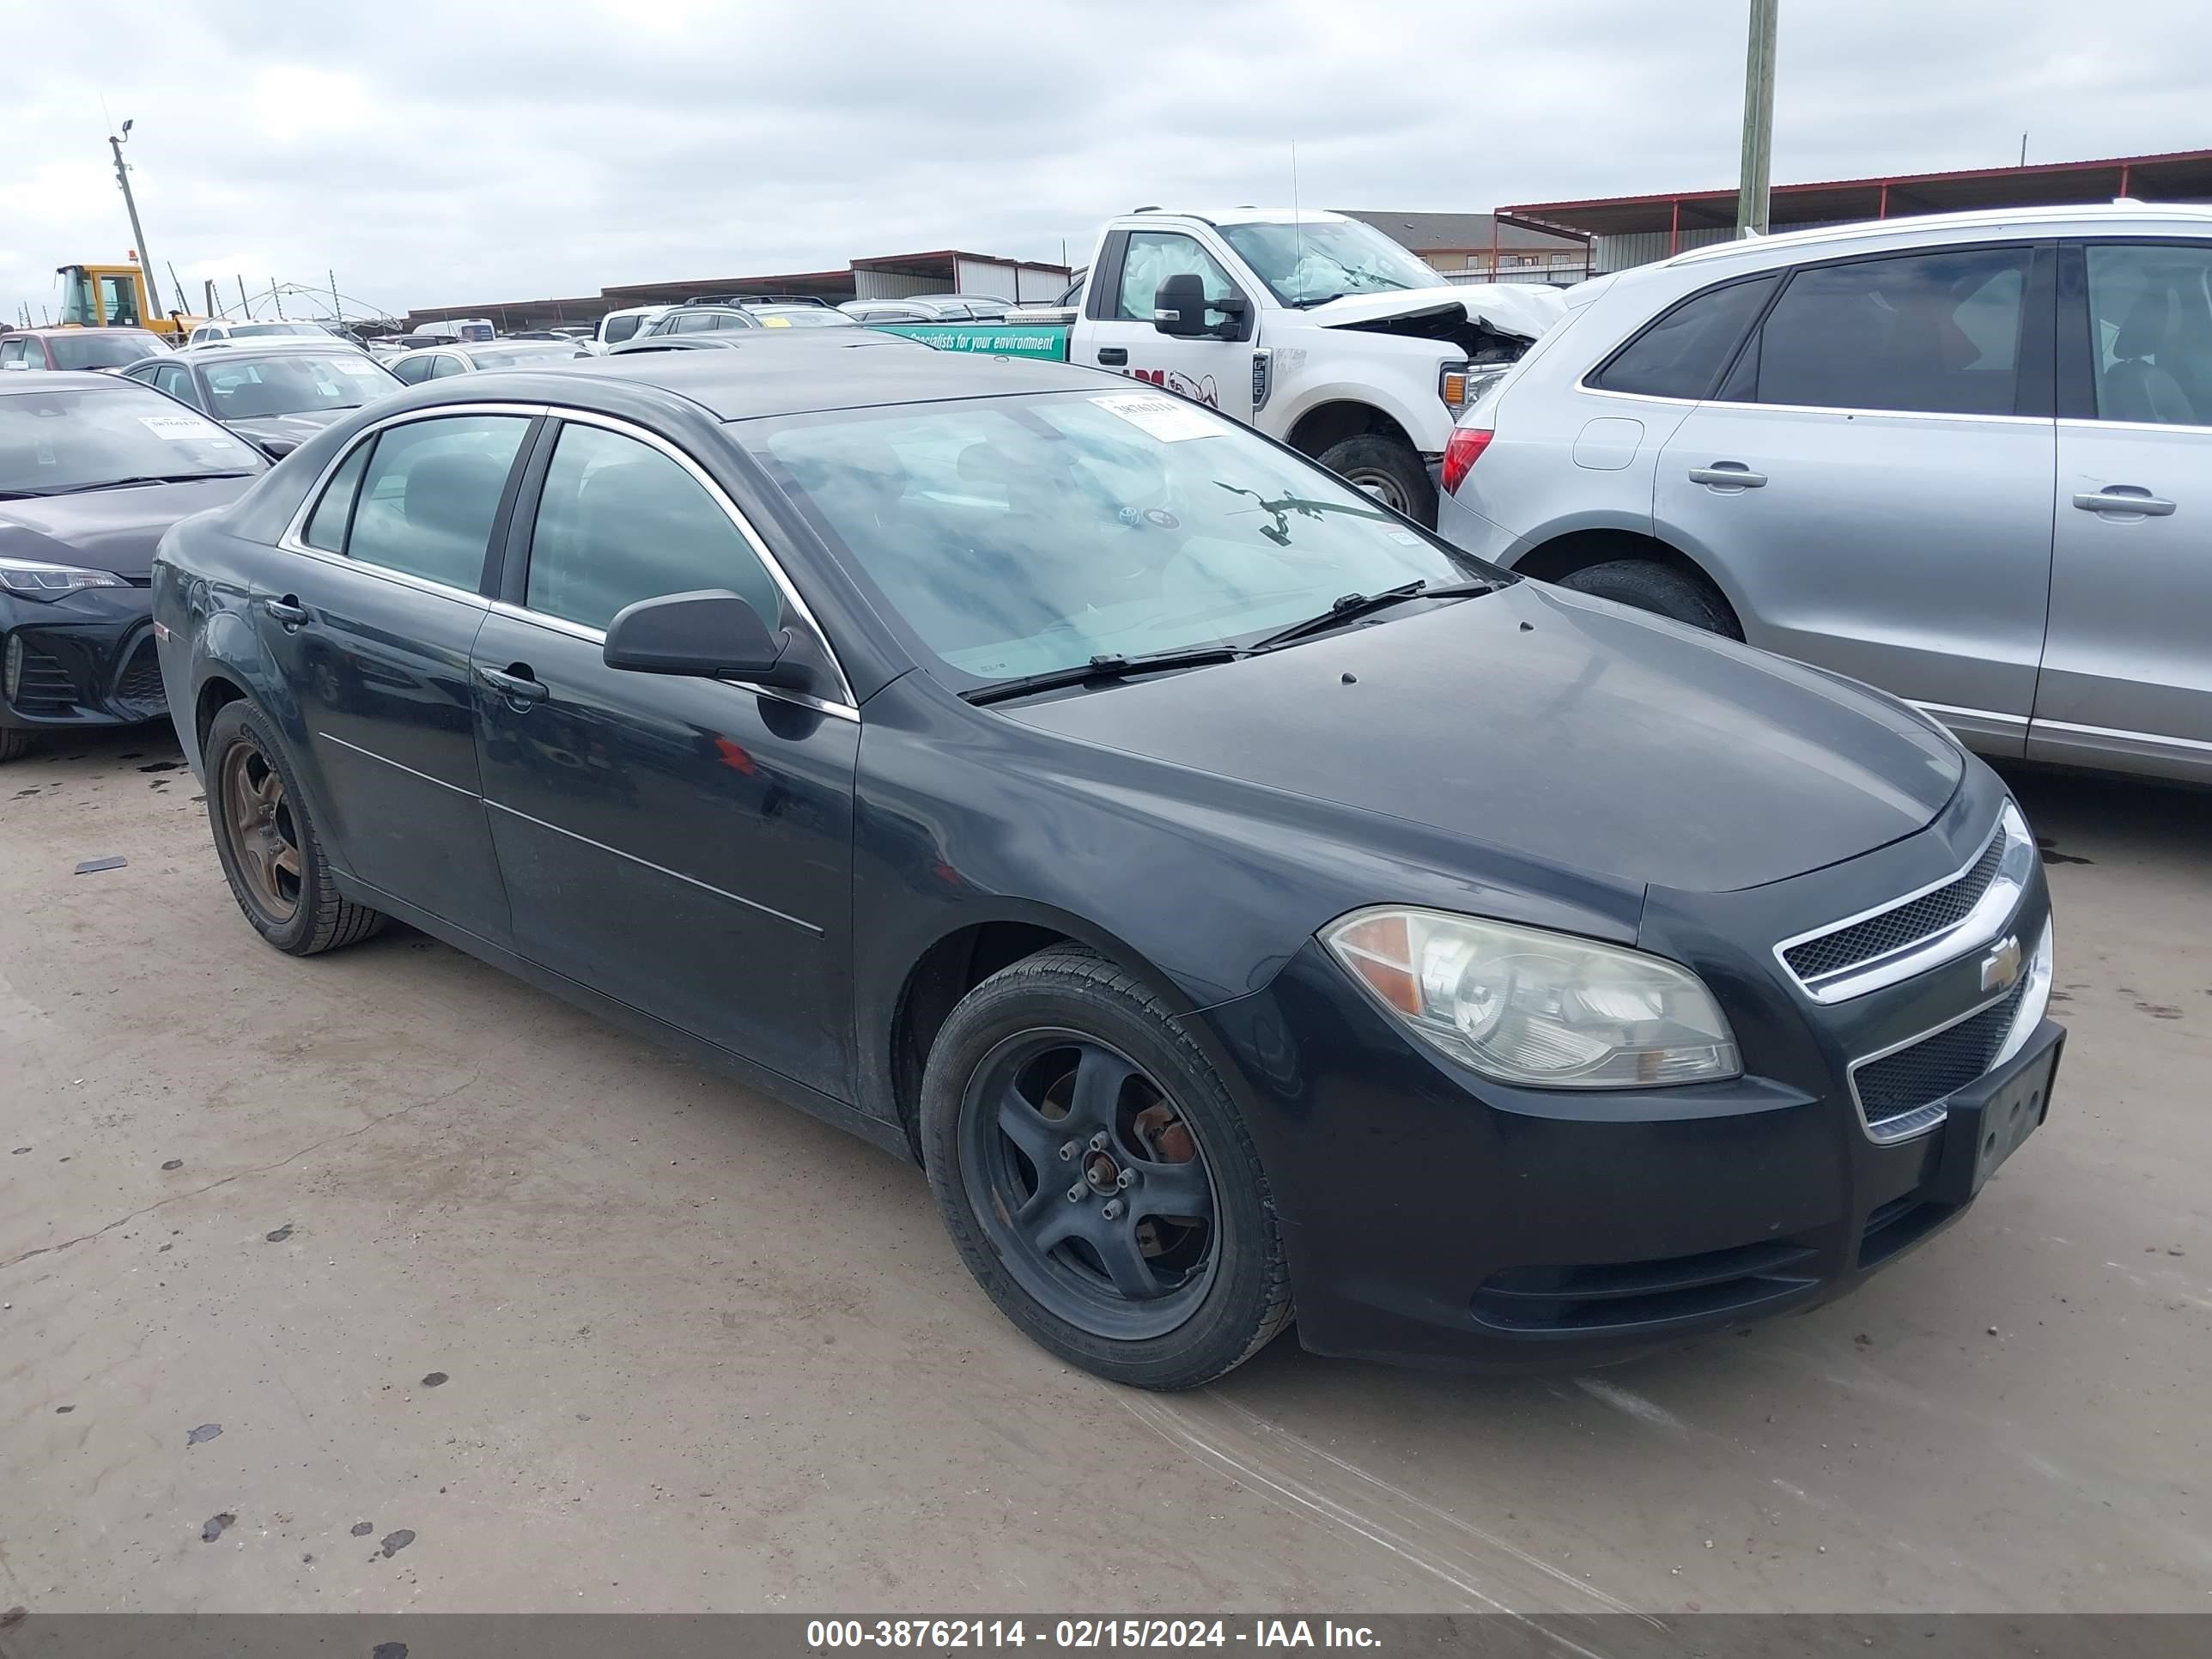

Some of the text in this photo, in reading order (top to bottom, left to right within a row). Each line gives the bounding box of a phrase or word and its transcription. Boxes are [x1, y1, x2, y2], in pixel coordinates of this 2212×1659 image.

[956, 333, 970, 349] for
[970, 336, 992, 352] your
[994, 334, 1055, 351] environment
[1254, 361, 1265, 395] F250
